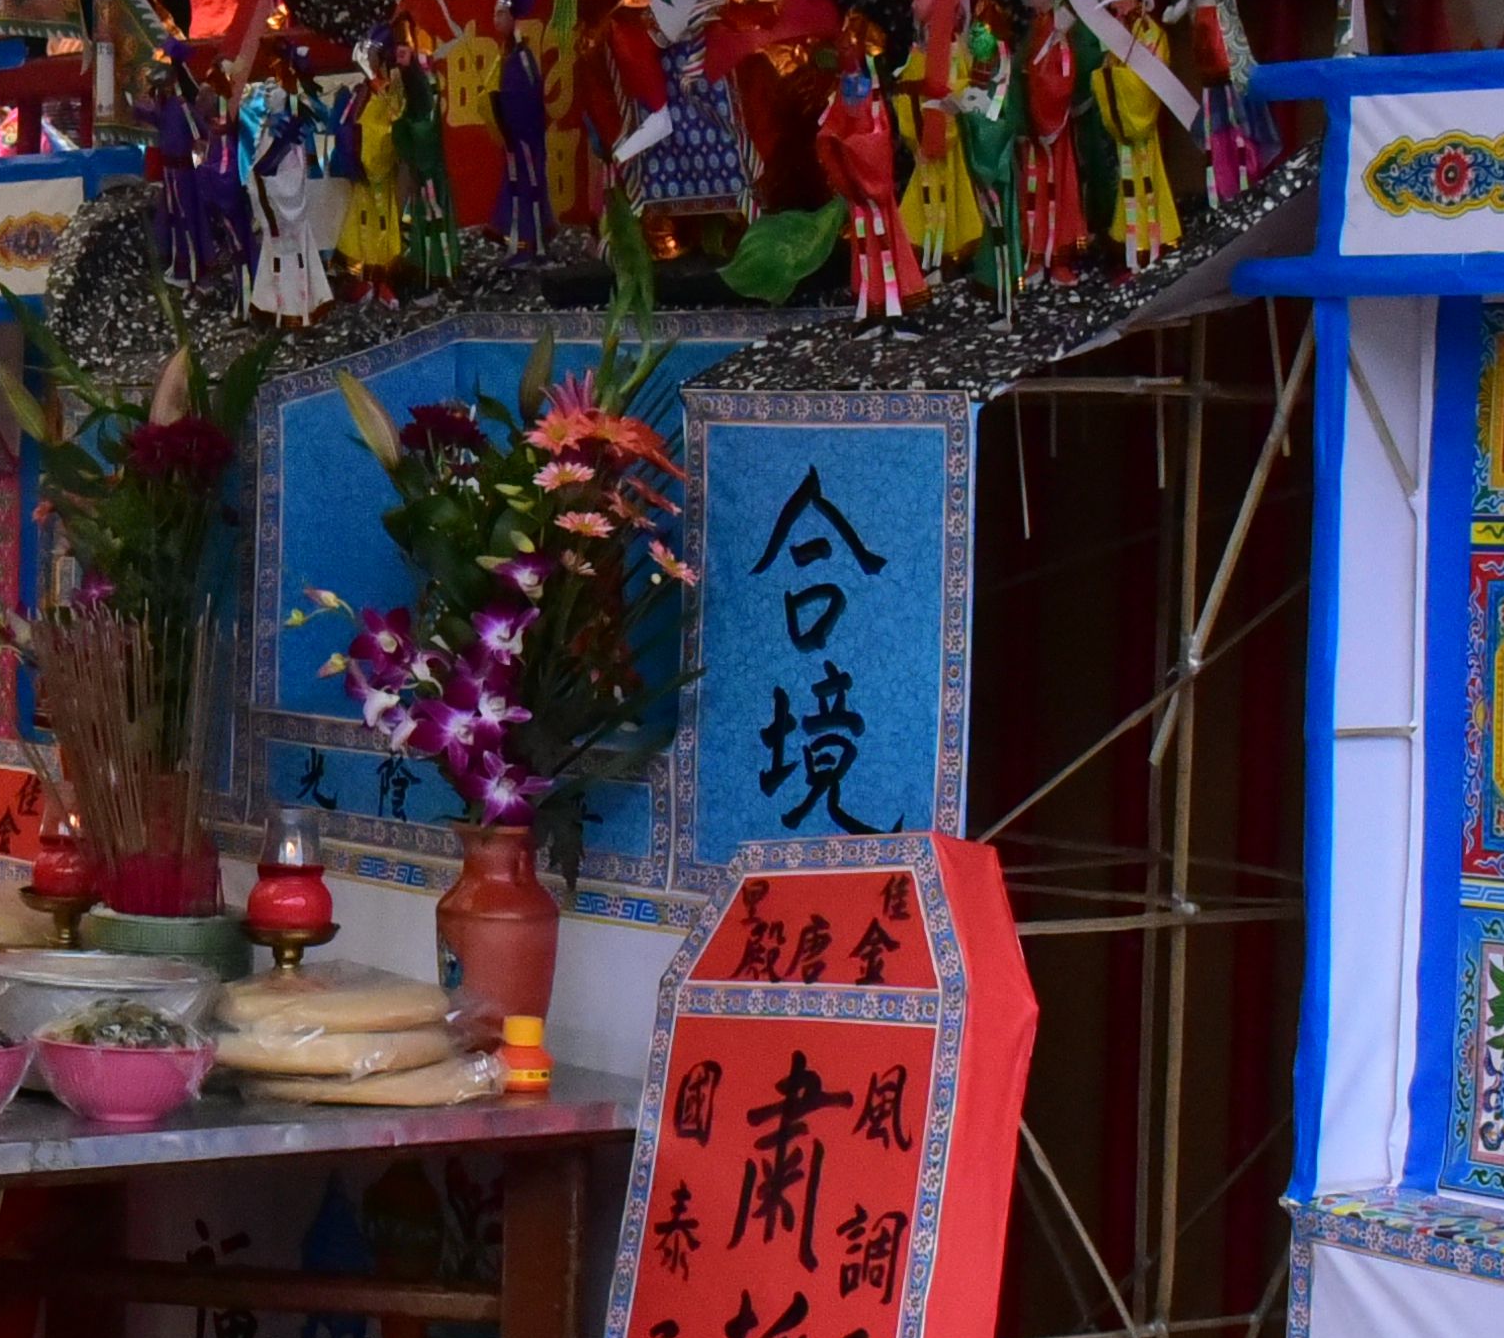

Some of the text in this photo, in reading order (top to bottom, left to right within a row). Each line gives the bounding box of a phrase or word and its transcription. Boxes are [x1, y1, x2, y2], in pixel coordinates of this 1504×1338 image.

[749, 463, 904, 835] 合境
[731, 913, 902, 986] 金唐殿
